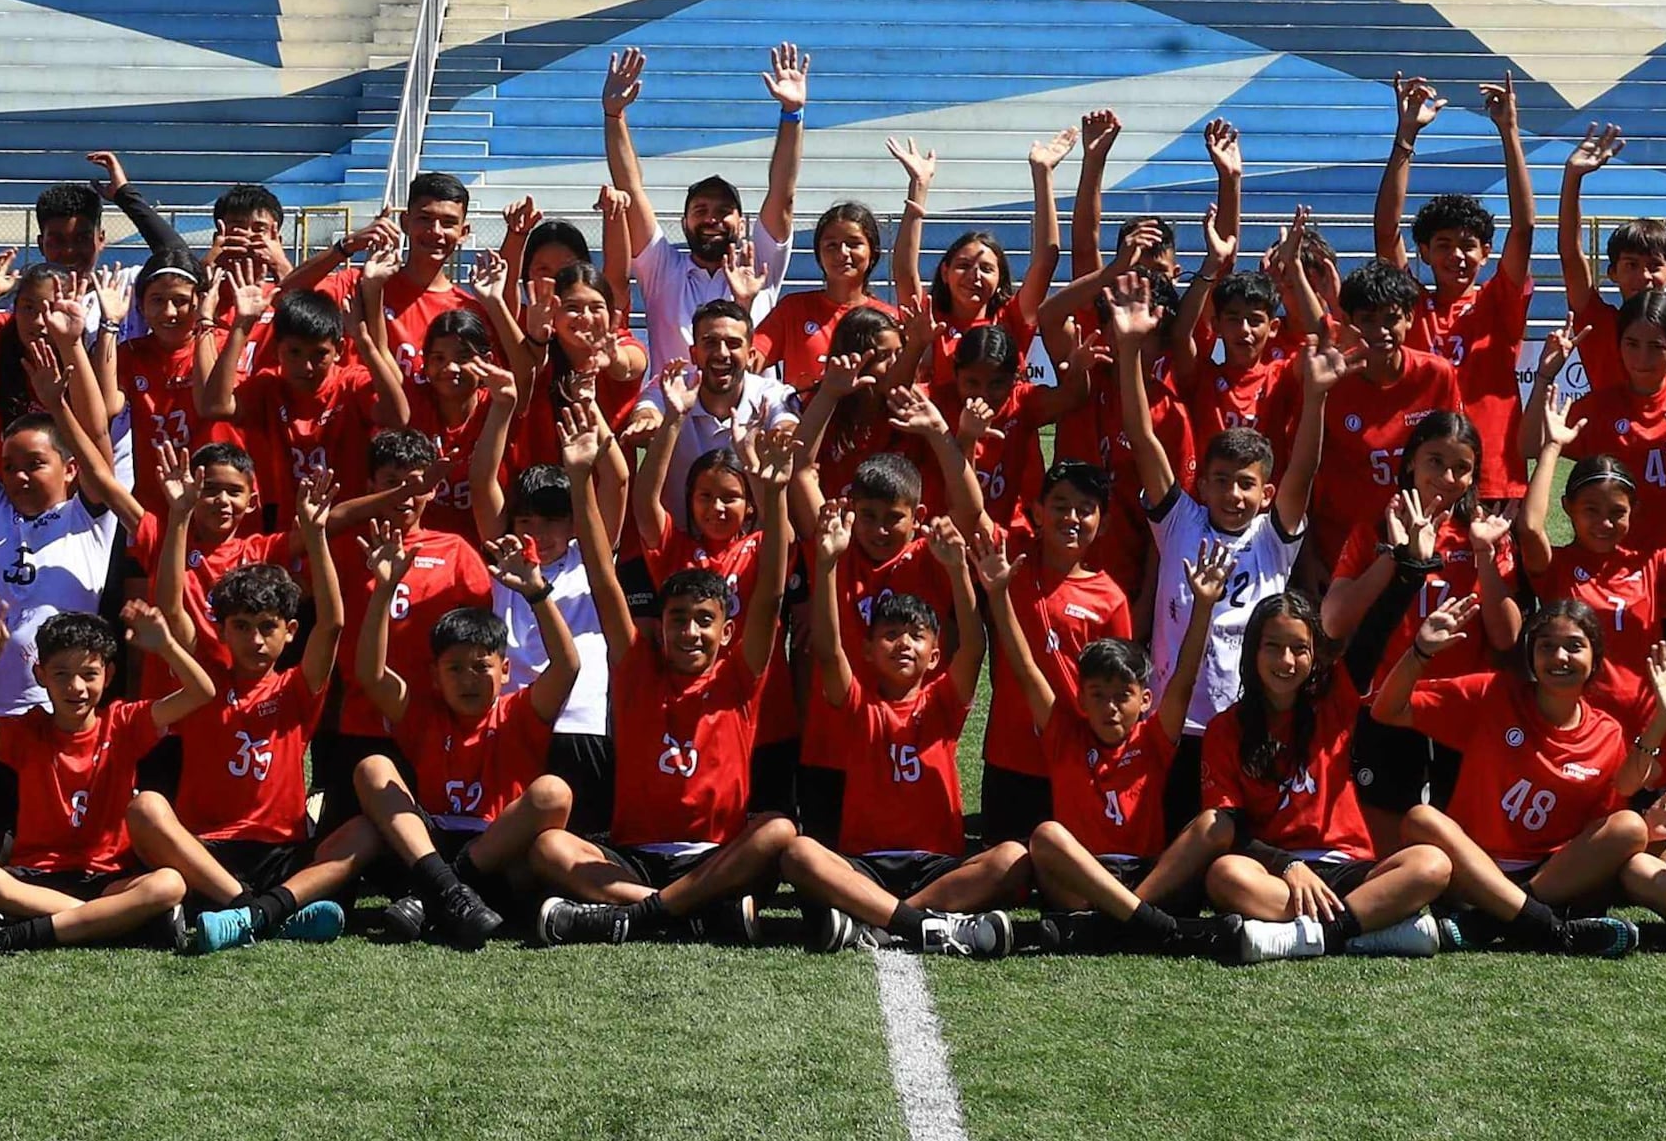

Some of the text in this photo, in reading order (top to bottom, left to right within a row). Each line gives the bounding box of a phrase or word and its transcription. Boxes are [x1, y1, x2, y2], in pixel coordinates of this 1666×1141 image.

[151, 410, 190, 449] 33
[390, 583, 411, 620] 6
[1607, 596, 1626, 631] 7
[890, 744, 921, 782] 15
[1105, 790, 1123, 826] 4
[1501, 778, 1556, 830] 48
